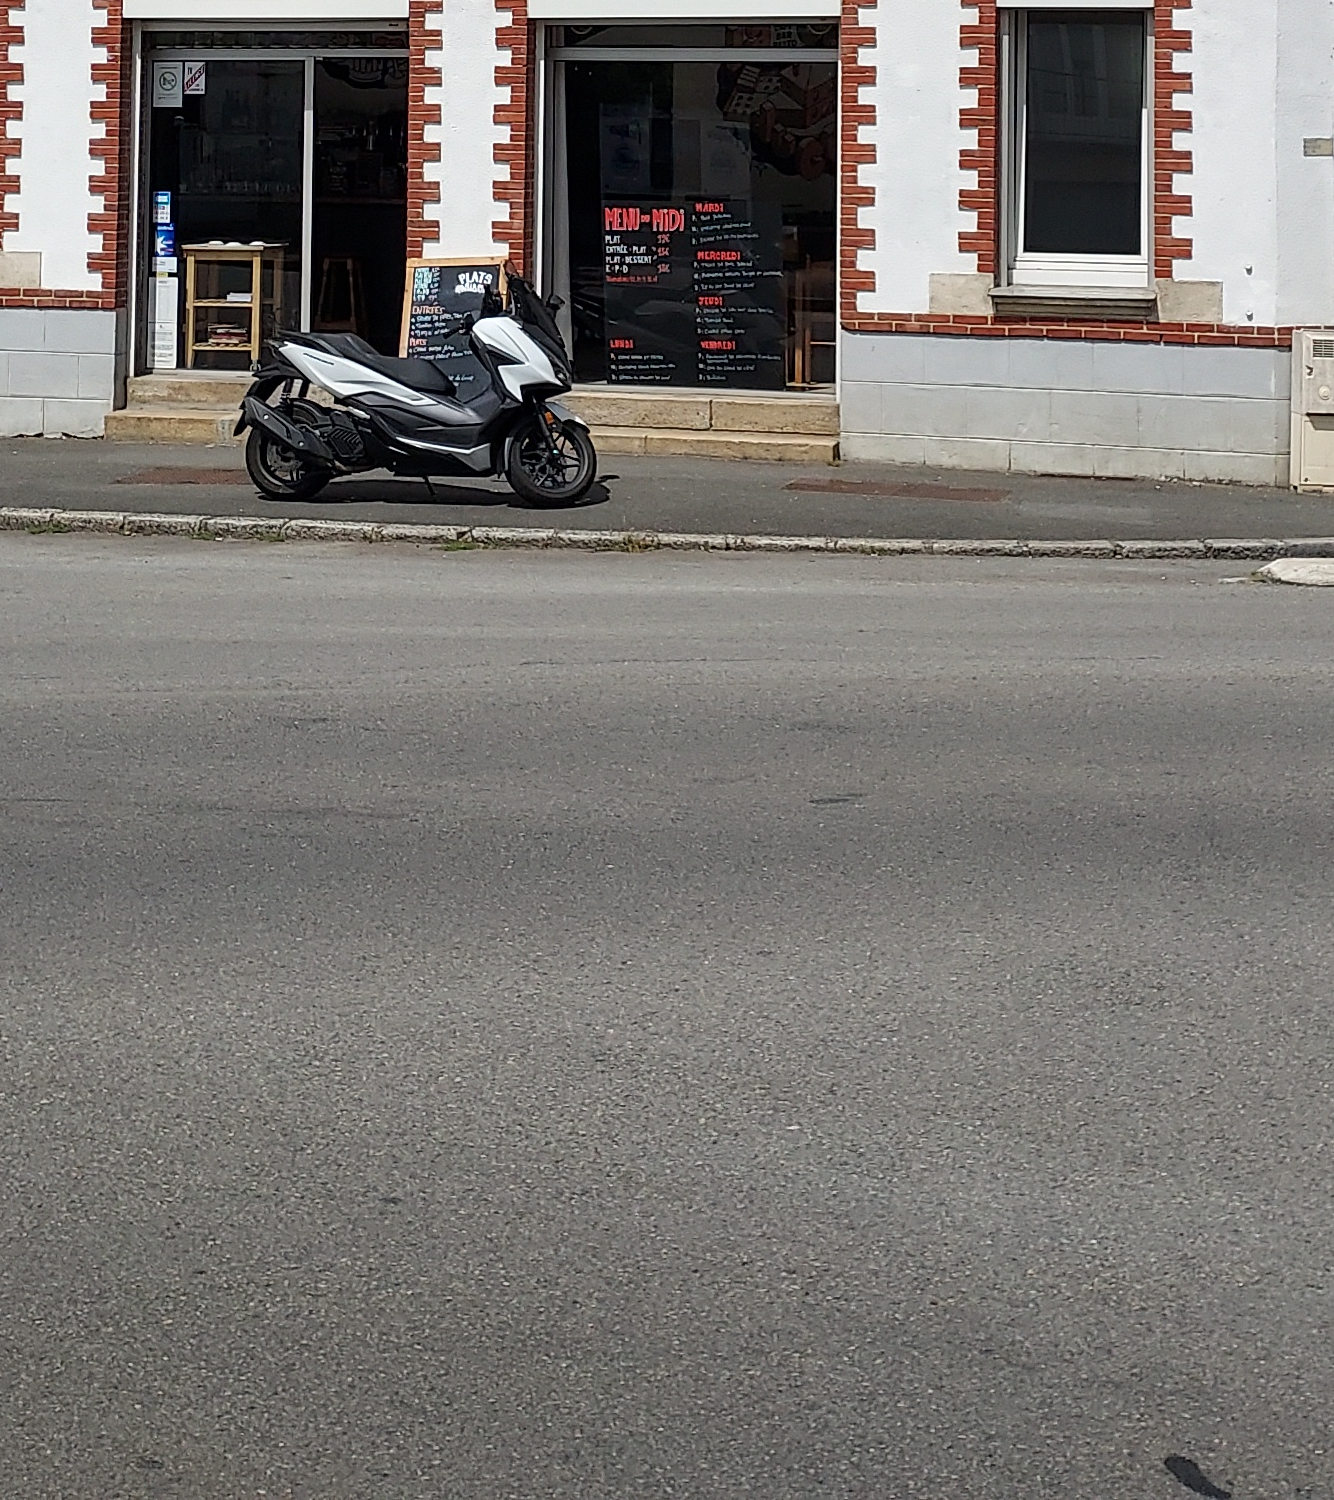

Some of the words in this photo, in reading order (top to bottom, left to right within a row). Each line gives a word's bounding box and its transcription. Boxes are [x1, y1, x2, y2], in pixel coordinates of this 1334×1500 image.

[604, 207, 641, 231] MENU
[605, 235, 621, 244] PLAT
[457, 270, 493, 285] PLATS
